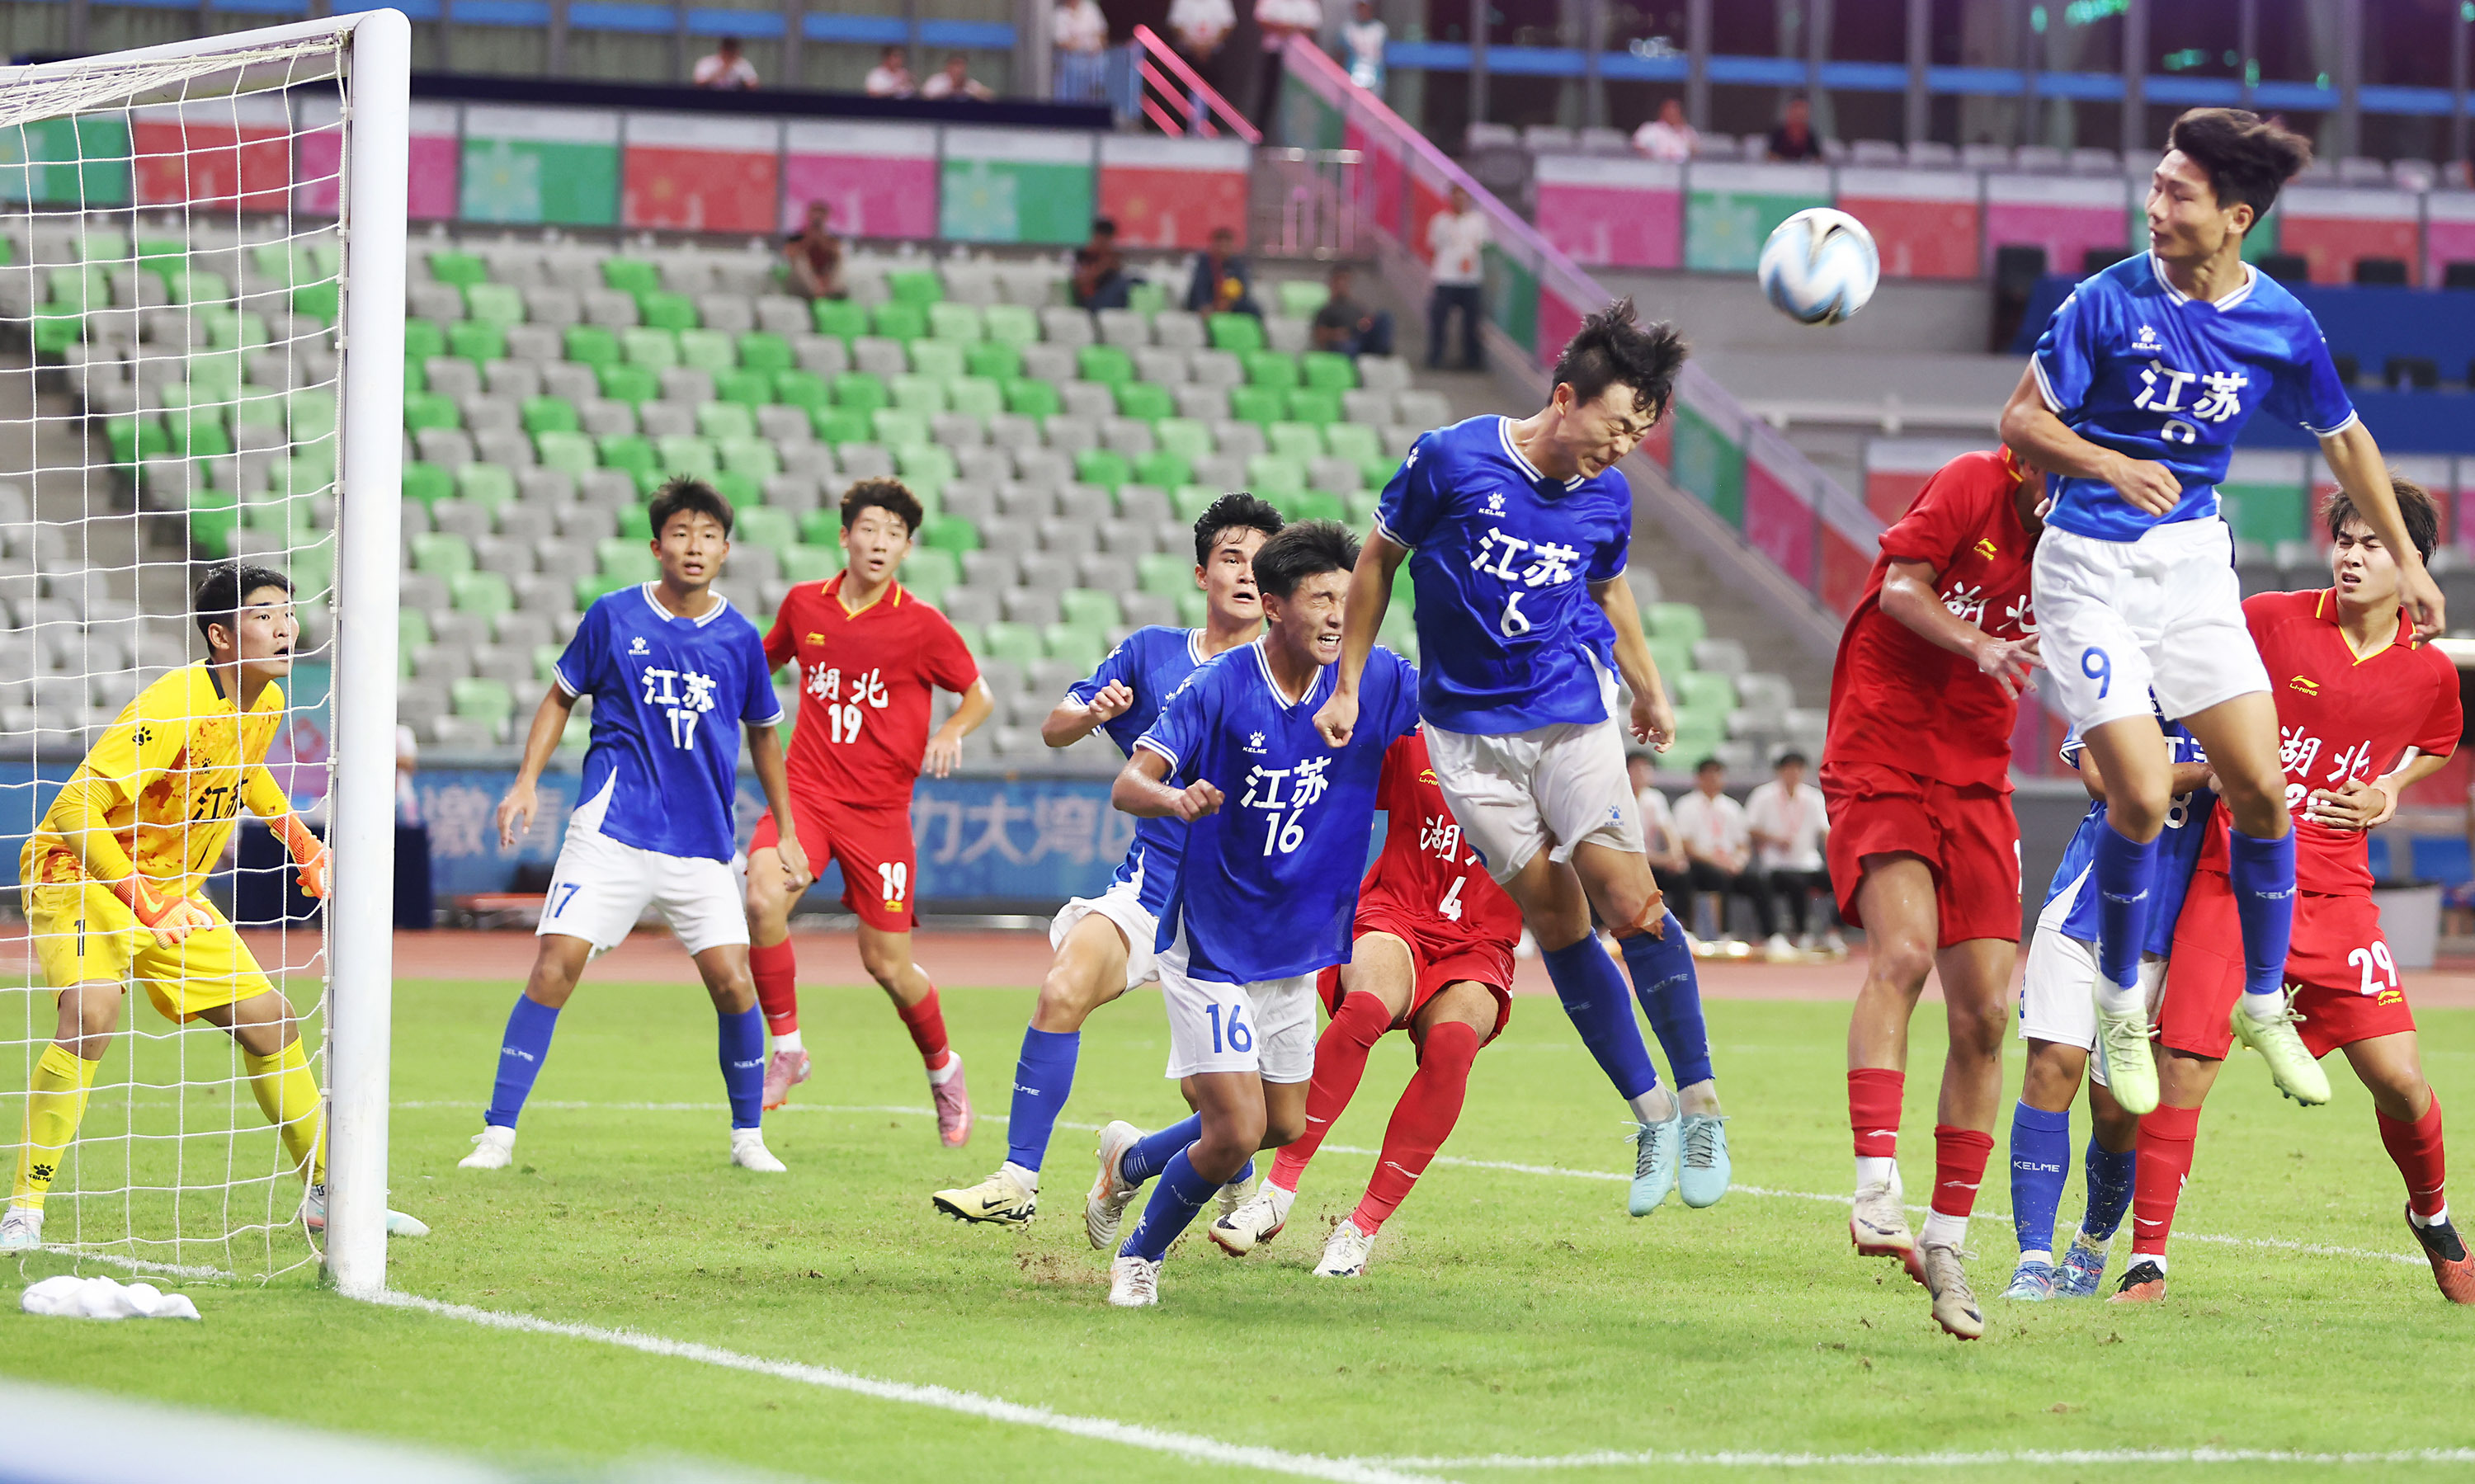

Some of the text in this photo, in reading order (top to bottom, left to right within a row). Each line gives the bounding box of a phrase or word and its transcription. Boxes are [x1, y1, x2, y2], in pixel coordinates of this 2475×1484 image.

[2133, 359, 2248, 423] 江苏
[1478, 507, 1506, 518] KELME
[1470, 526, 1580, 587] 江苏
[1501, 591, 1530, 638] 6
[641, 665, 717, 713] 江苏
[807, 661, 889, 708] 湖北
[2081, 646, 2111, 700] 9
[2289, 682, 2318, 696] LI-NING
[666, 708, 700, 750] 17
[828, 703, 863, 743] 19
[1242, 746, 1268, 755] KELME
[2278, 725, 2371, 782] 湖北
[1240, 756, 1332, 809] 江苏
[1263, 808, 1304, 856] 16
[1420, 813, 1478, 866] 湖
[545, 882, 582, 918] 17
[878, 861, 907, 901] 19
[1439, 875, 1467, 921] 4
[74, 919, 85, 956] 1
[1647, 973, 1689, 994] KELME
[2348, 940, 2397, 995] 29
[1206, 1003, 1252, 1053] 16
[2013, 1160, 2061, 1172] KELME
